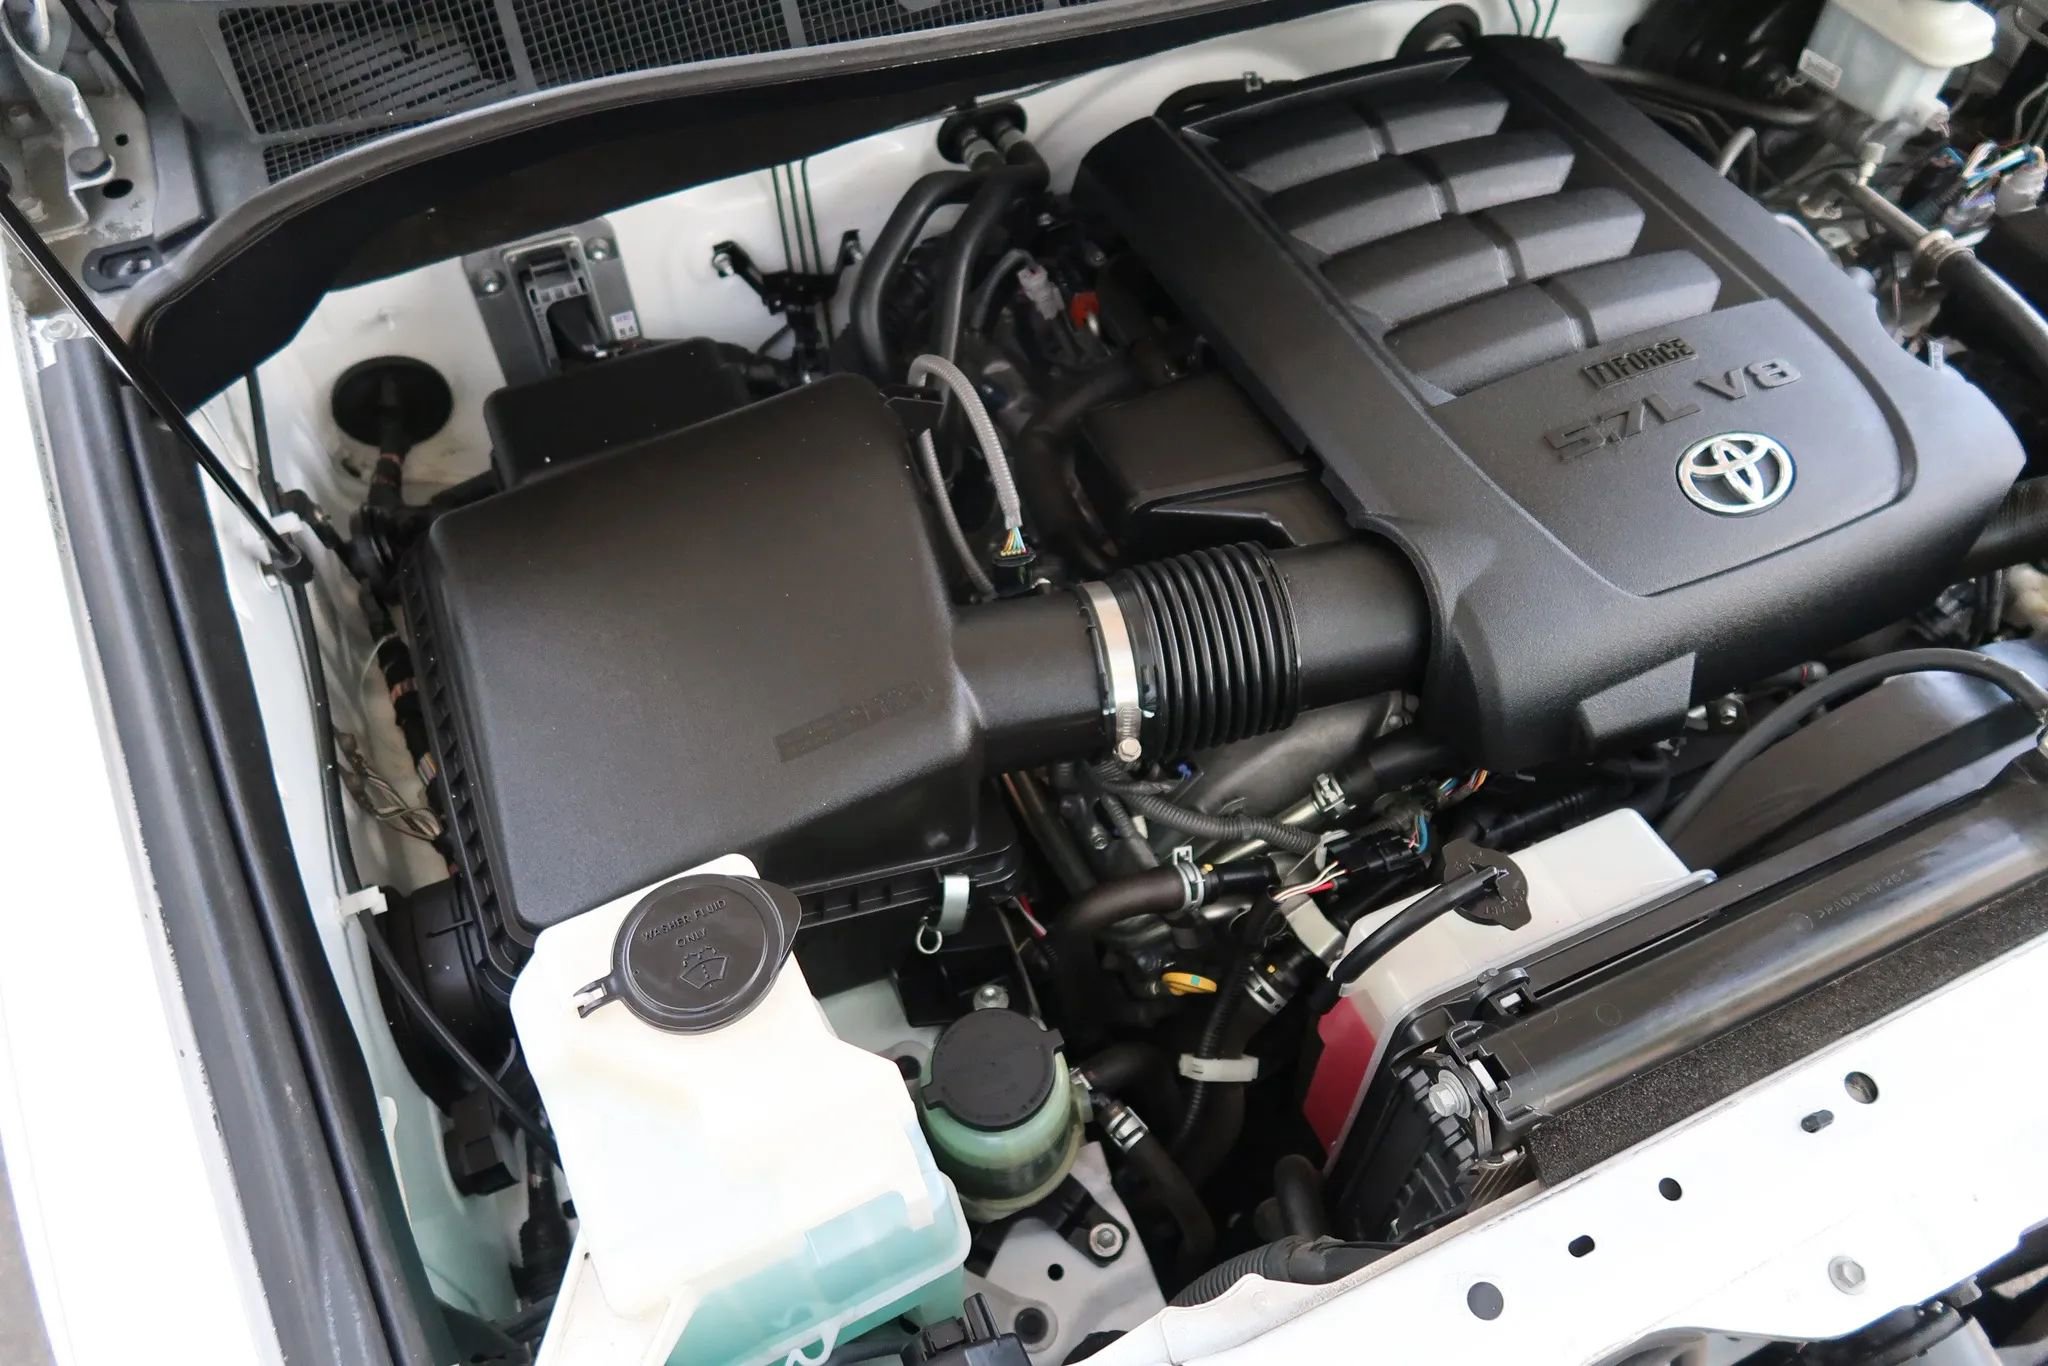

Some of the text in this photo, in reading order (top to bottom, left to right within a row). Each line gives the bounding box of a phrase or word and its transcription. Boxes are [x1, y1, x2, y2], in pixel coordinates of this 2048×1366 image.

[1696, 358, 1801, 401] V8
[642, 899, 727, 942] WASHER FLUID
[675, 927, 708, 948] ONLY
